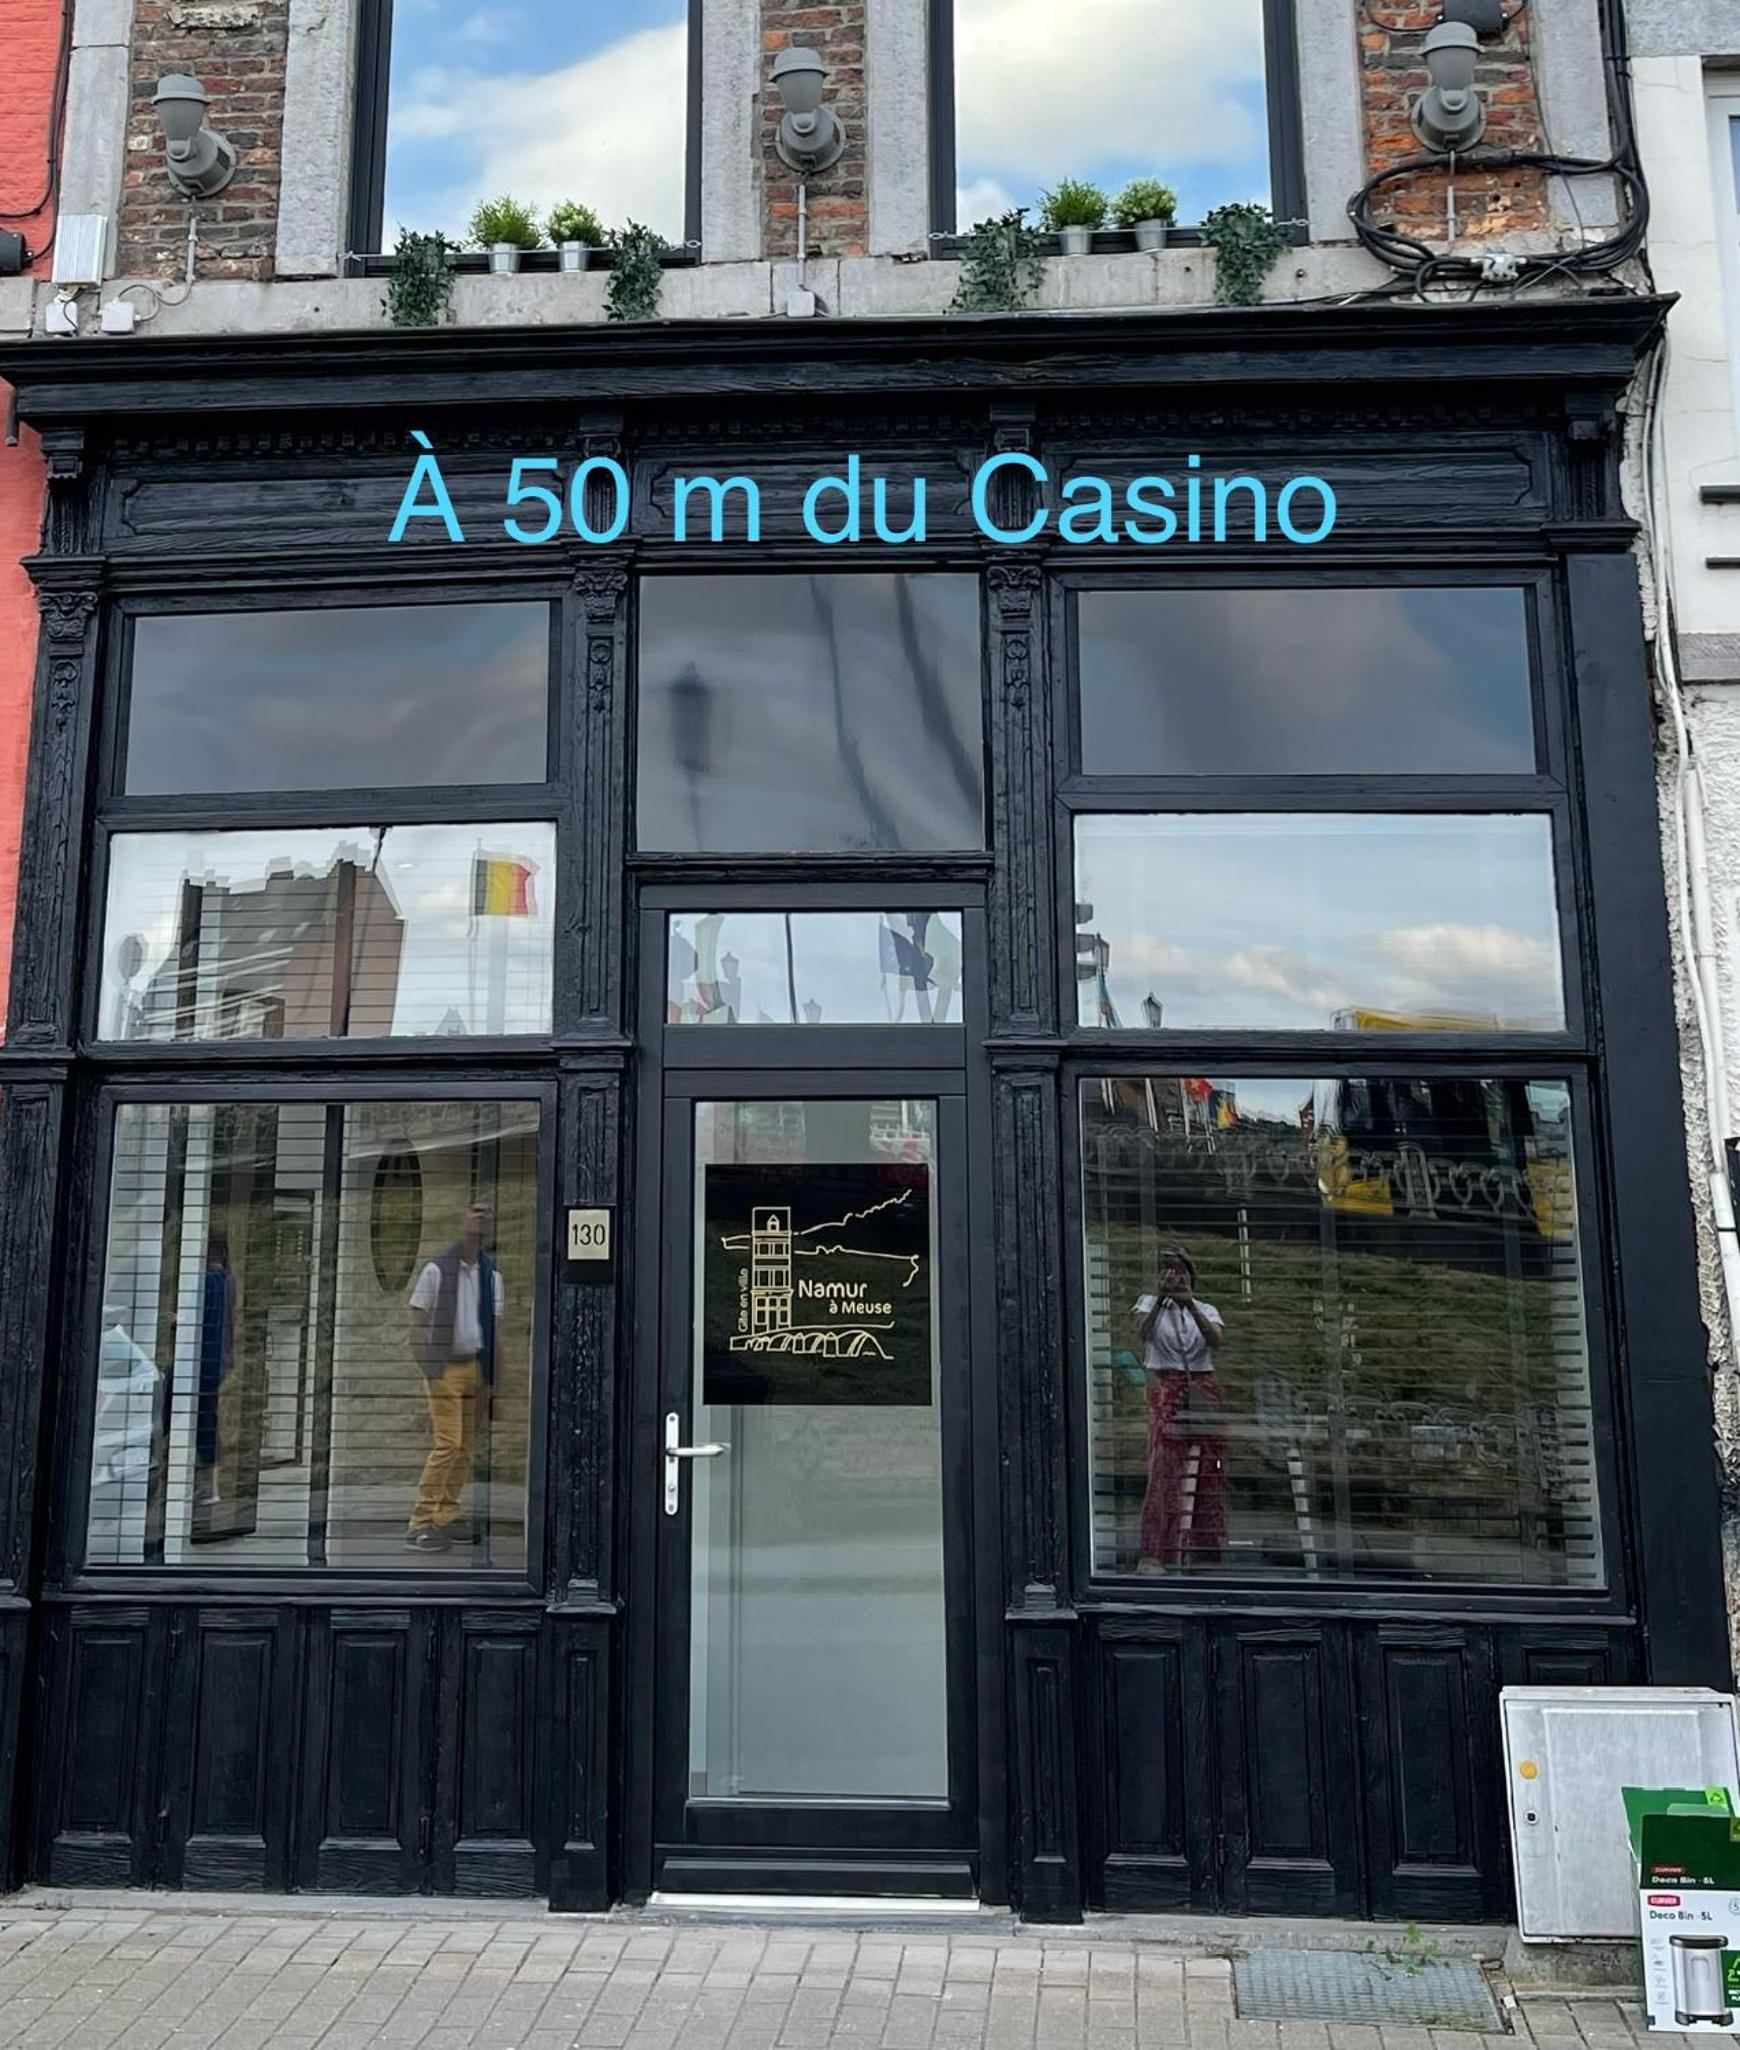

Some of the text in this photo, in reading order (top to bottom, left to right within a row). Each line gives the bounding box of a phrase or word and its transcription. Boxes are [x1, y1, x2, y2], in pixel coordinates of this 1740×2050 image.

[572, 1224, 605, 1246] 130
[798, 1279, 868, 1298] Namur
[740, 1293, 748, 1308] en
[829, 1299, 892, 1314] à Meuse
[1651, 1876, 1678, 1884] Deco
[1649, 1910, 1713, 1921] Deco Bin 5L
